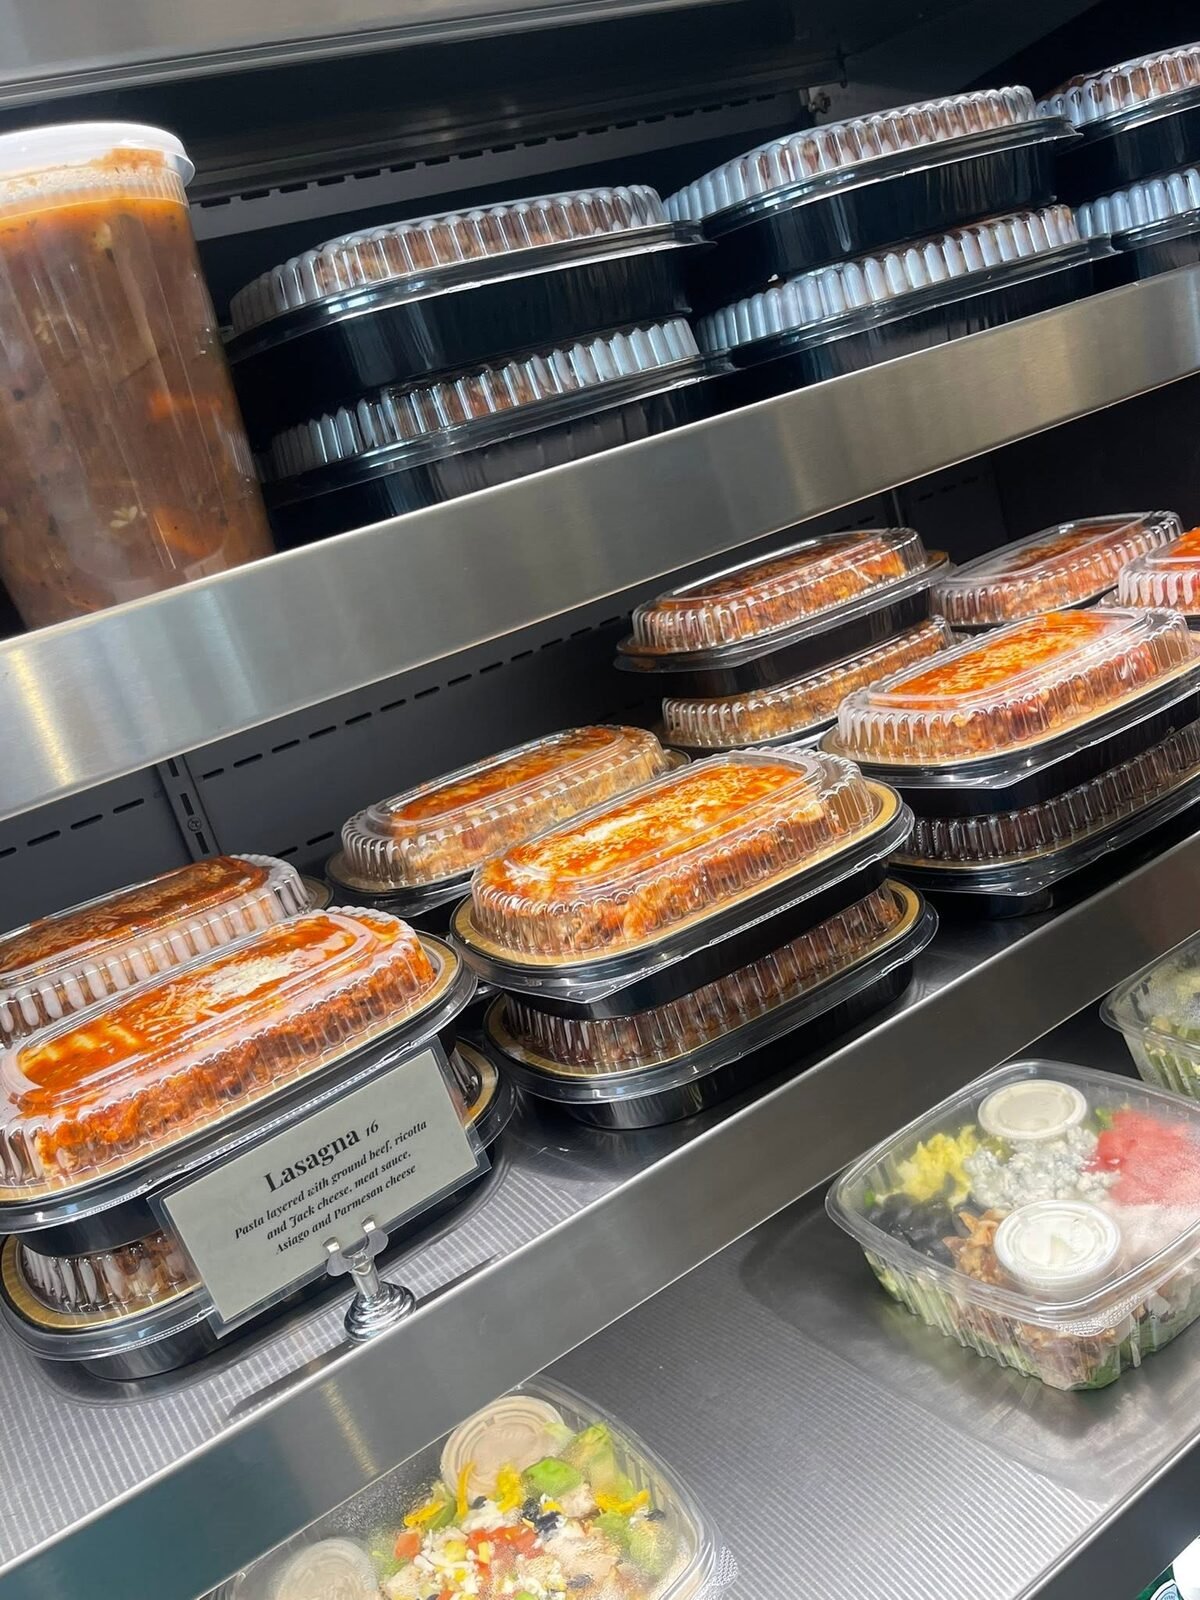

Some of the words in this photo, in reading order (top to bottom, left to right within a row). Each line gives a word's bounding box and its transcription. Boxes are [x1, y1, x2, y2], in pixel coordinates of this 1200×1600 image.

[235, 1217, 265, 1240] Pasta
[266, 1190, 305, 1220] layered
[307, 1177, 329, 1197] with
[331, 1154, 367, 1185] ground
[395, 1121, 427, 1146] ricotta
[264, 1130, 361, 1193] Lasagna
[366, 1120, 379, 1137] 16
[267, 1220, 287, 1240] and
[288, 1205, 315, 1229] Jack
[354, 1167, 379, 1189] meat
[275, 1229, 310, 1255] Asiago
[312, 1213, 332, 1233] and
[334, 1186, 384, 1220] Parmesan
[385, 1165, 416, 1189] cheese
